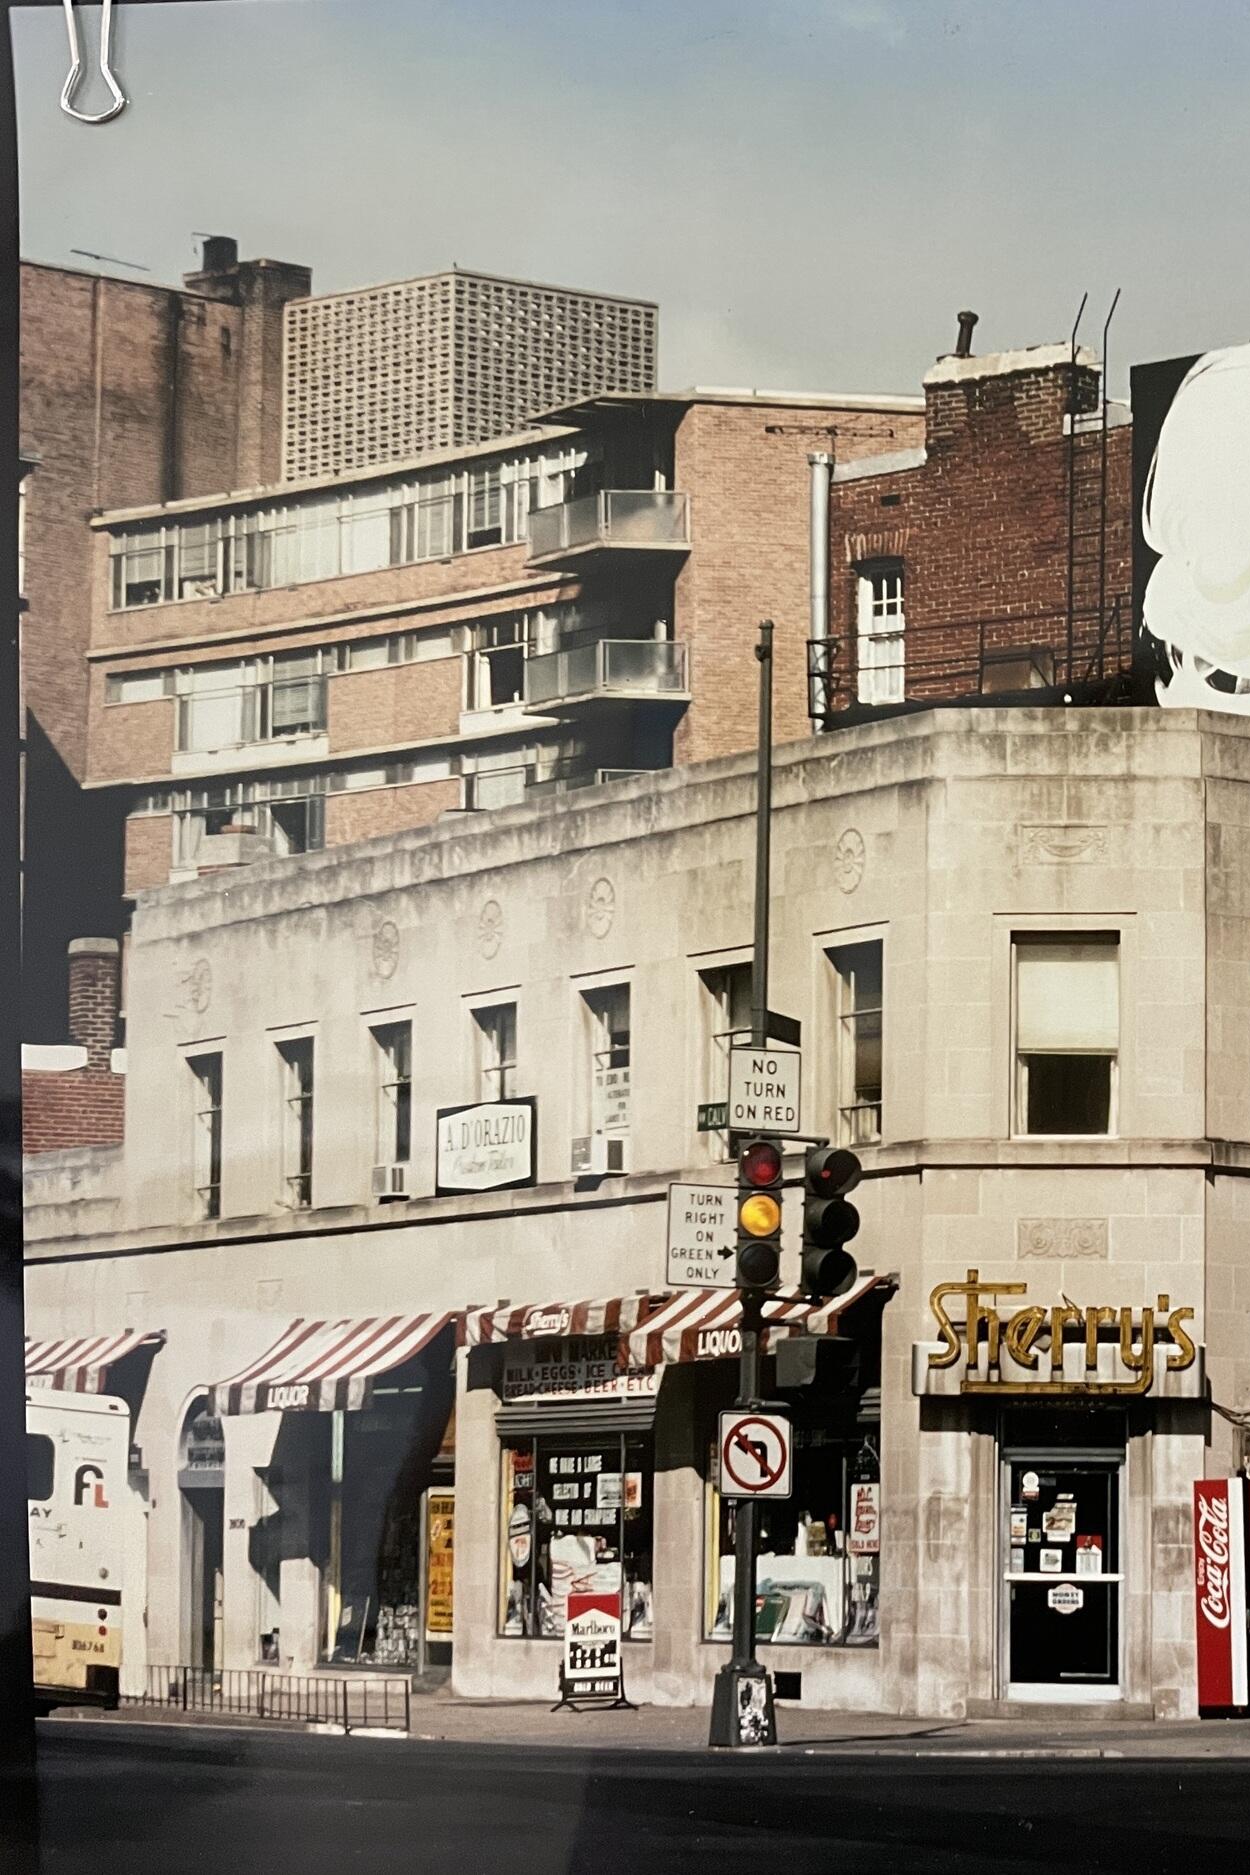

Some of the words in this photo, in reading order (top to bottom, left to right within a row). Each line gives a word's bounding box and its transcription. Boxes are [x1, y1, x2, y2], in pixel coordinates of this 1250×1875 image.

[752, 1059, 777, 1075] NO
[744, 1081, 786, 1099] TURN
[735, 1104, 756, 1119] ON
[763, 1106, 795, 1122] RED
[461, 1114, 526, 1150] D'ORAZIO
[690, 1193, 723, 1206] TURN
[685, 1211, 725, 1225] RIGHT
[696, 1230, 714, 1242] ON
[671, 1247, 714, 1260] GREEN
[686, 1266, 719, 1279] ONLY
[696, 1325, 744, 1356] LIQUO
[927, 1268, 1197, 1396] Sherry's
[569, 1340, 618, 1361] MARKE
[541, 1363, 577, 1381] EGGS
[586, 1362, 605, 1378] ICE
[584, 1376, 617, 1393] BEER
[267, 1385, 310, 1409] LIQUOR
[571, 1620, 616, 1636] Marlboro
